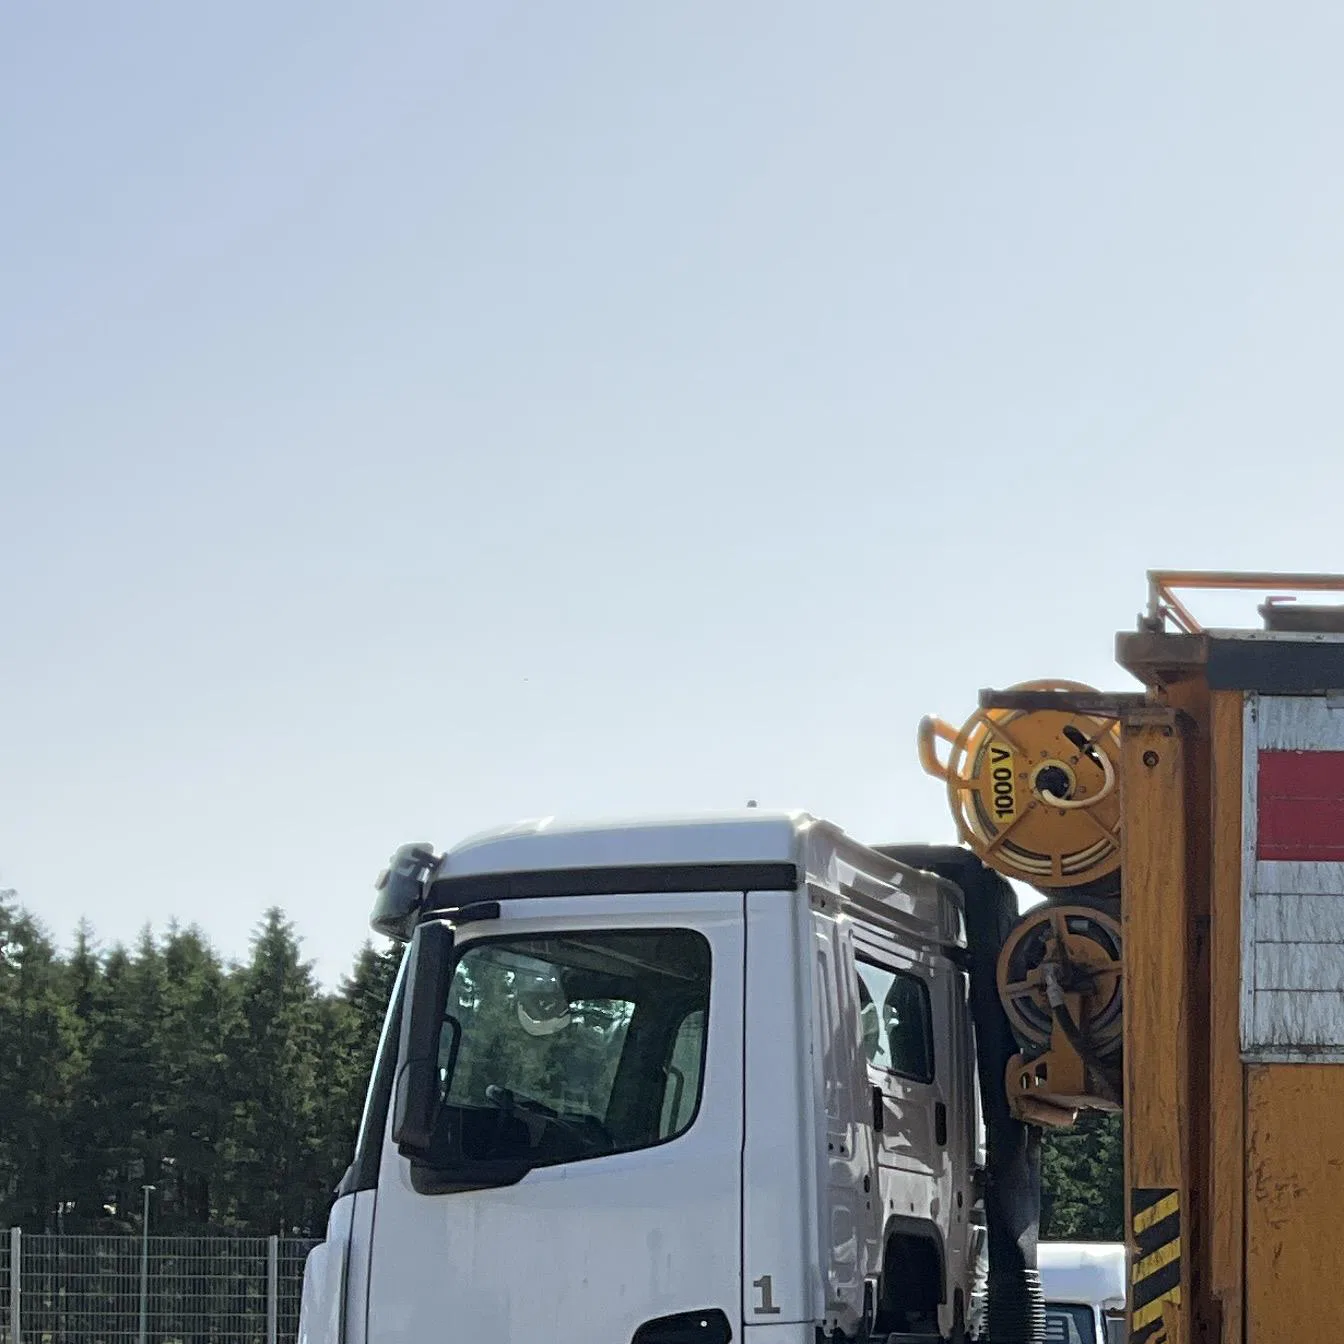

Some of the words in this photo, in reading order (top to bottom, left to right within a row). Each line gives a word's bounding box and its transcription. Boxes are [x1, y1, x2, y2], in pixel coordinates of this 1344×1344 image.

[991, 748, 1010, 763] V
[993, 767, 1014, 818] 1000
[753, 1275, 781, 1314] 1
